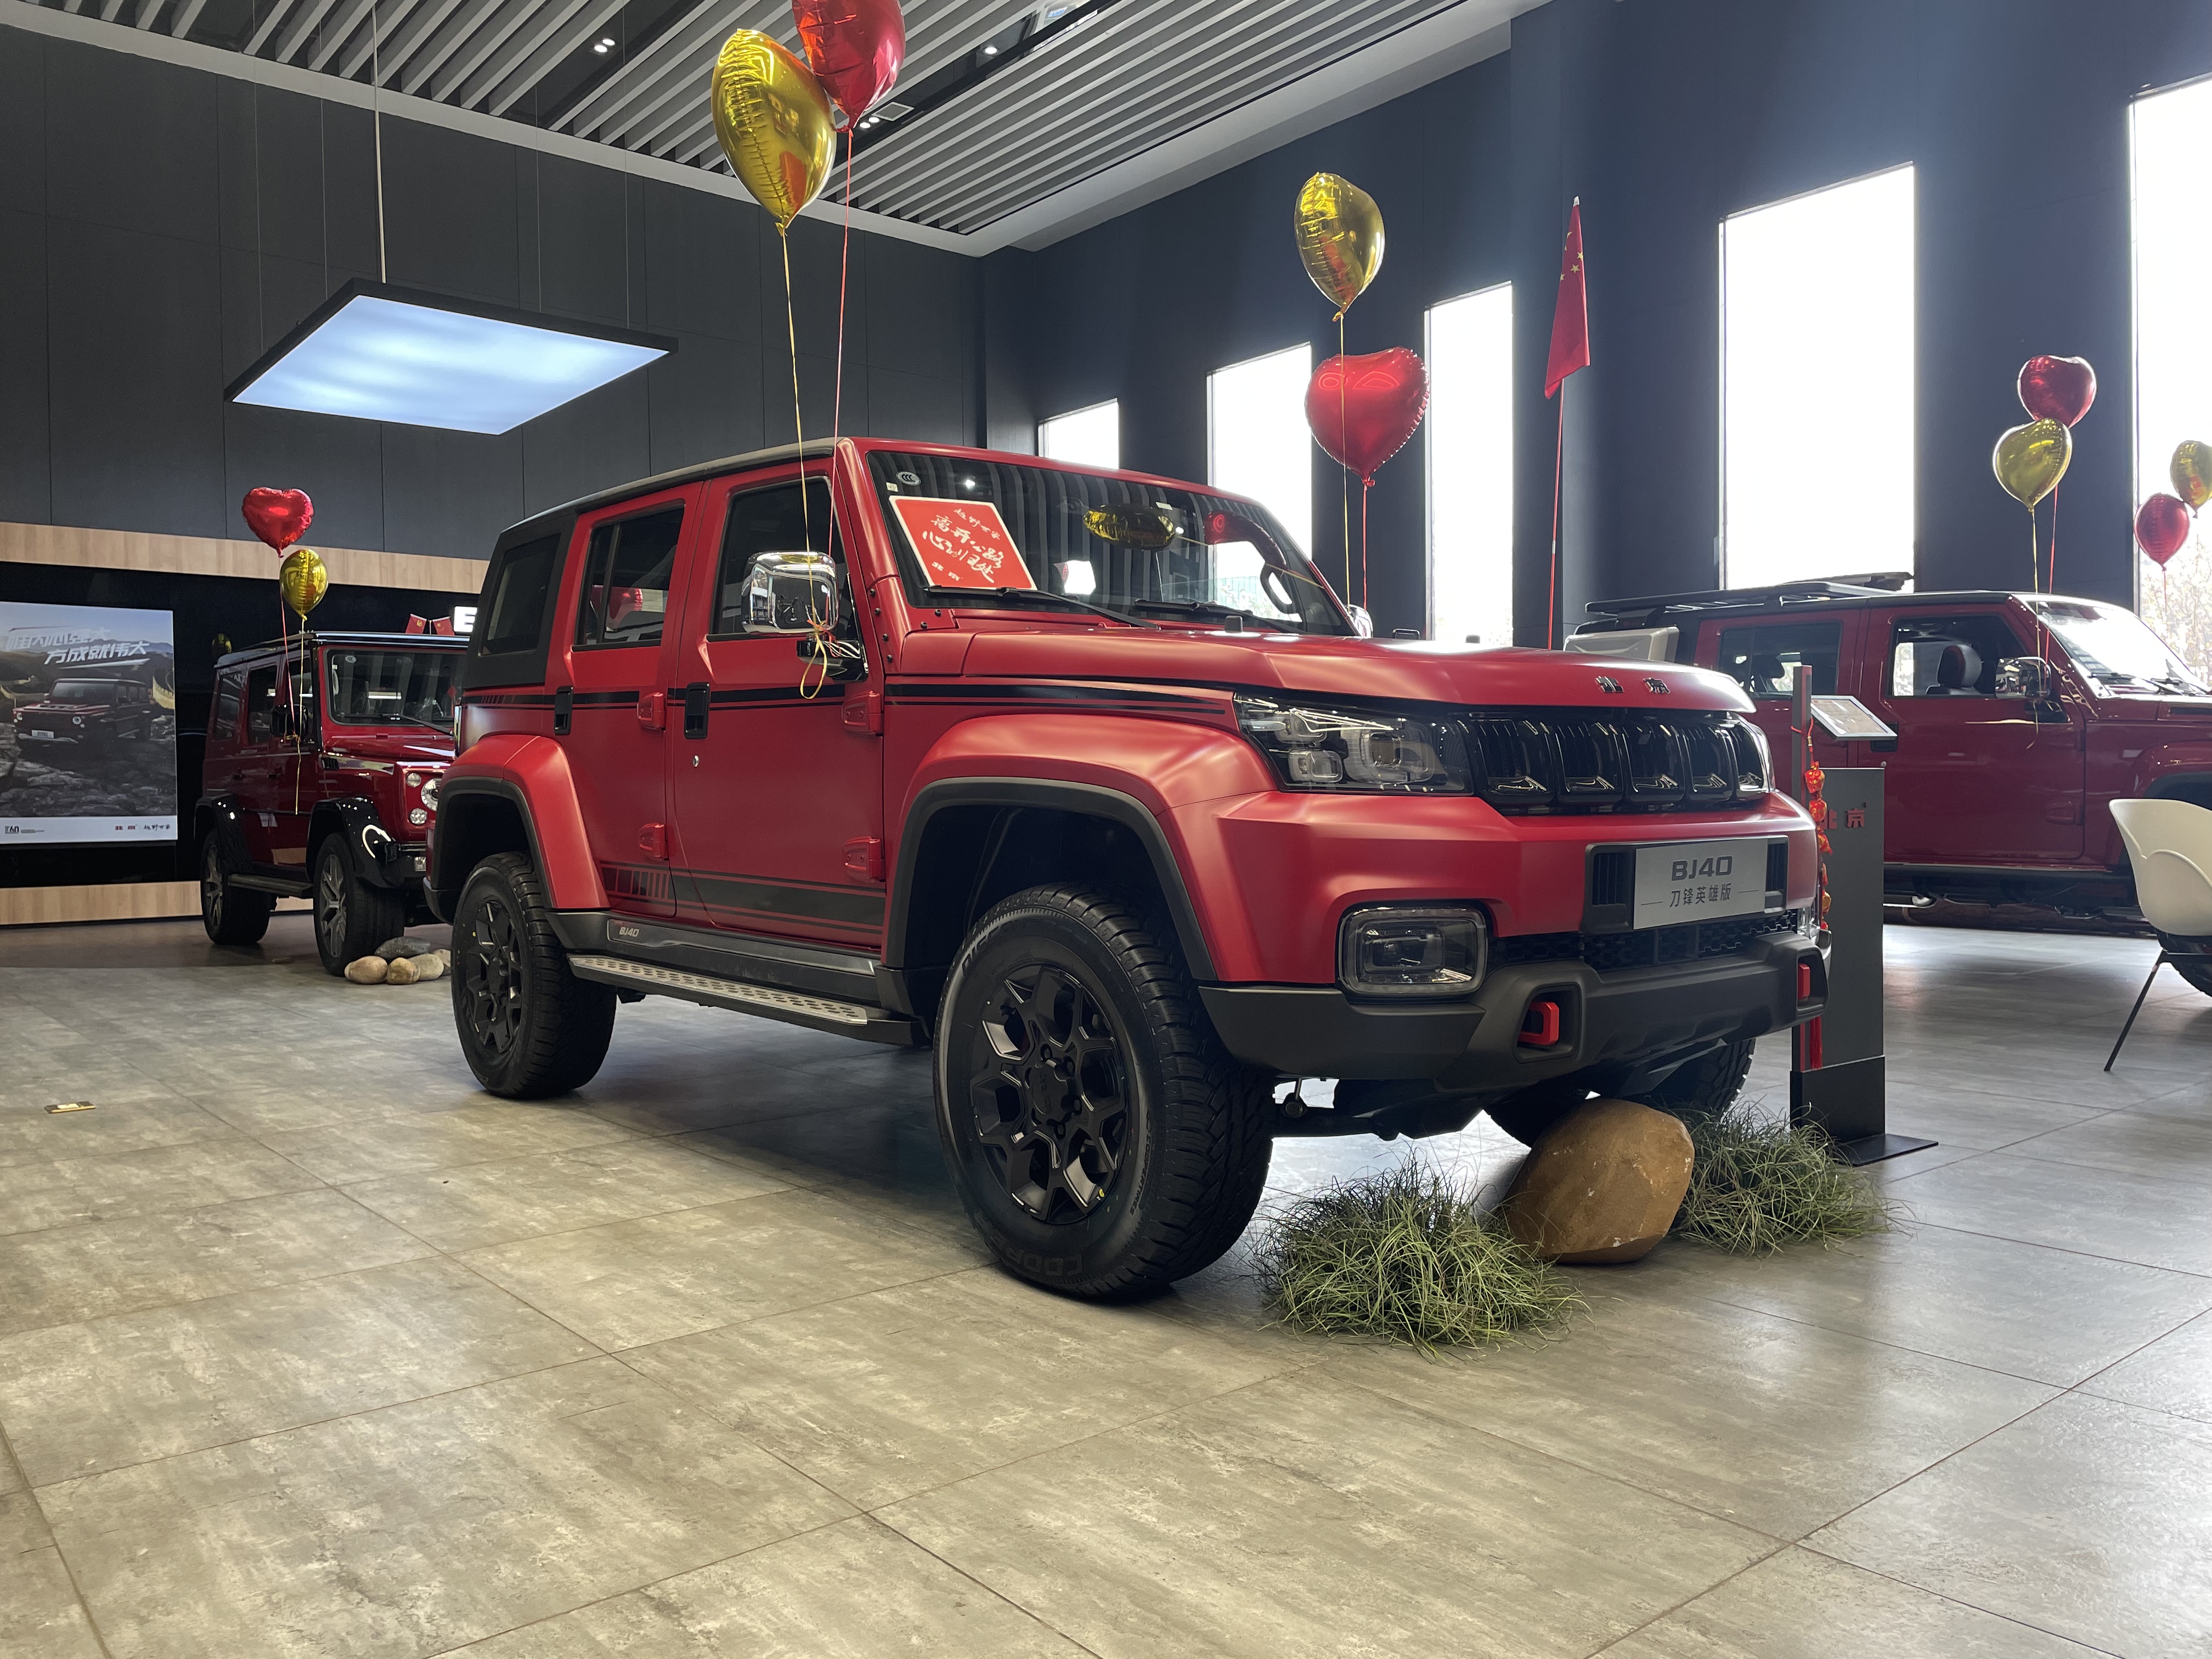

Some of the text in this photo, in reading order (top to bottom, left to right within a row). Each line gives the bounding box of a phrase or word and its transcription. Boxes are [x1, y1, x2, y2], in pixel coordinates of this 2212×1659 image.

[953, 508, 1001, 540] 越野世家
[930, 515, 1005, 568] 离开公路
[932, 561, 961, 582] 北京
[44, 641, 150, 665] 方成就伟大
[1594, 675, 1671, 693] 北京
[1820, 808, 1865, 830] 北京
[1672, 856, 1733, 881] BJ40
[1669, 882, 1731, 908] 刀锋英雄版
[619, 927, 640, 937] BJ40
